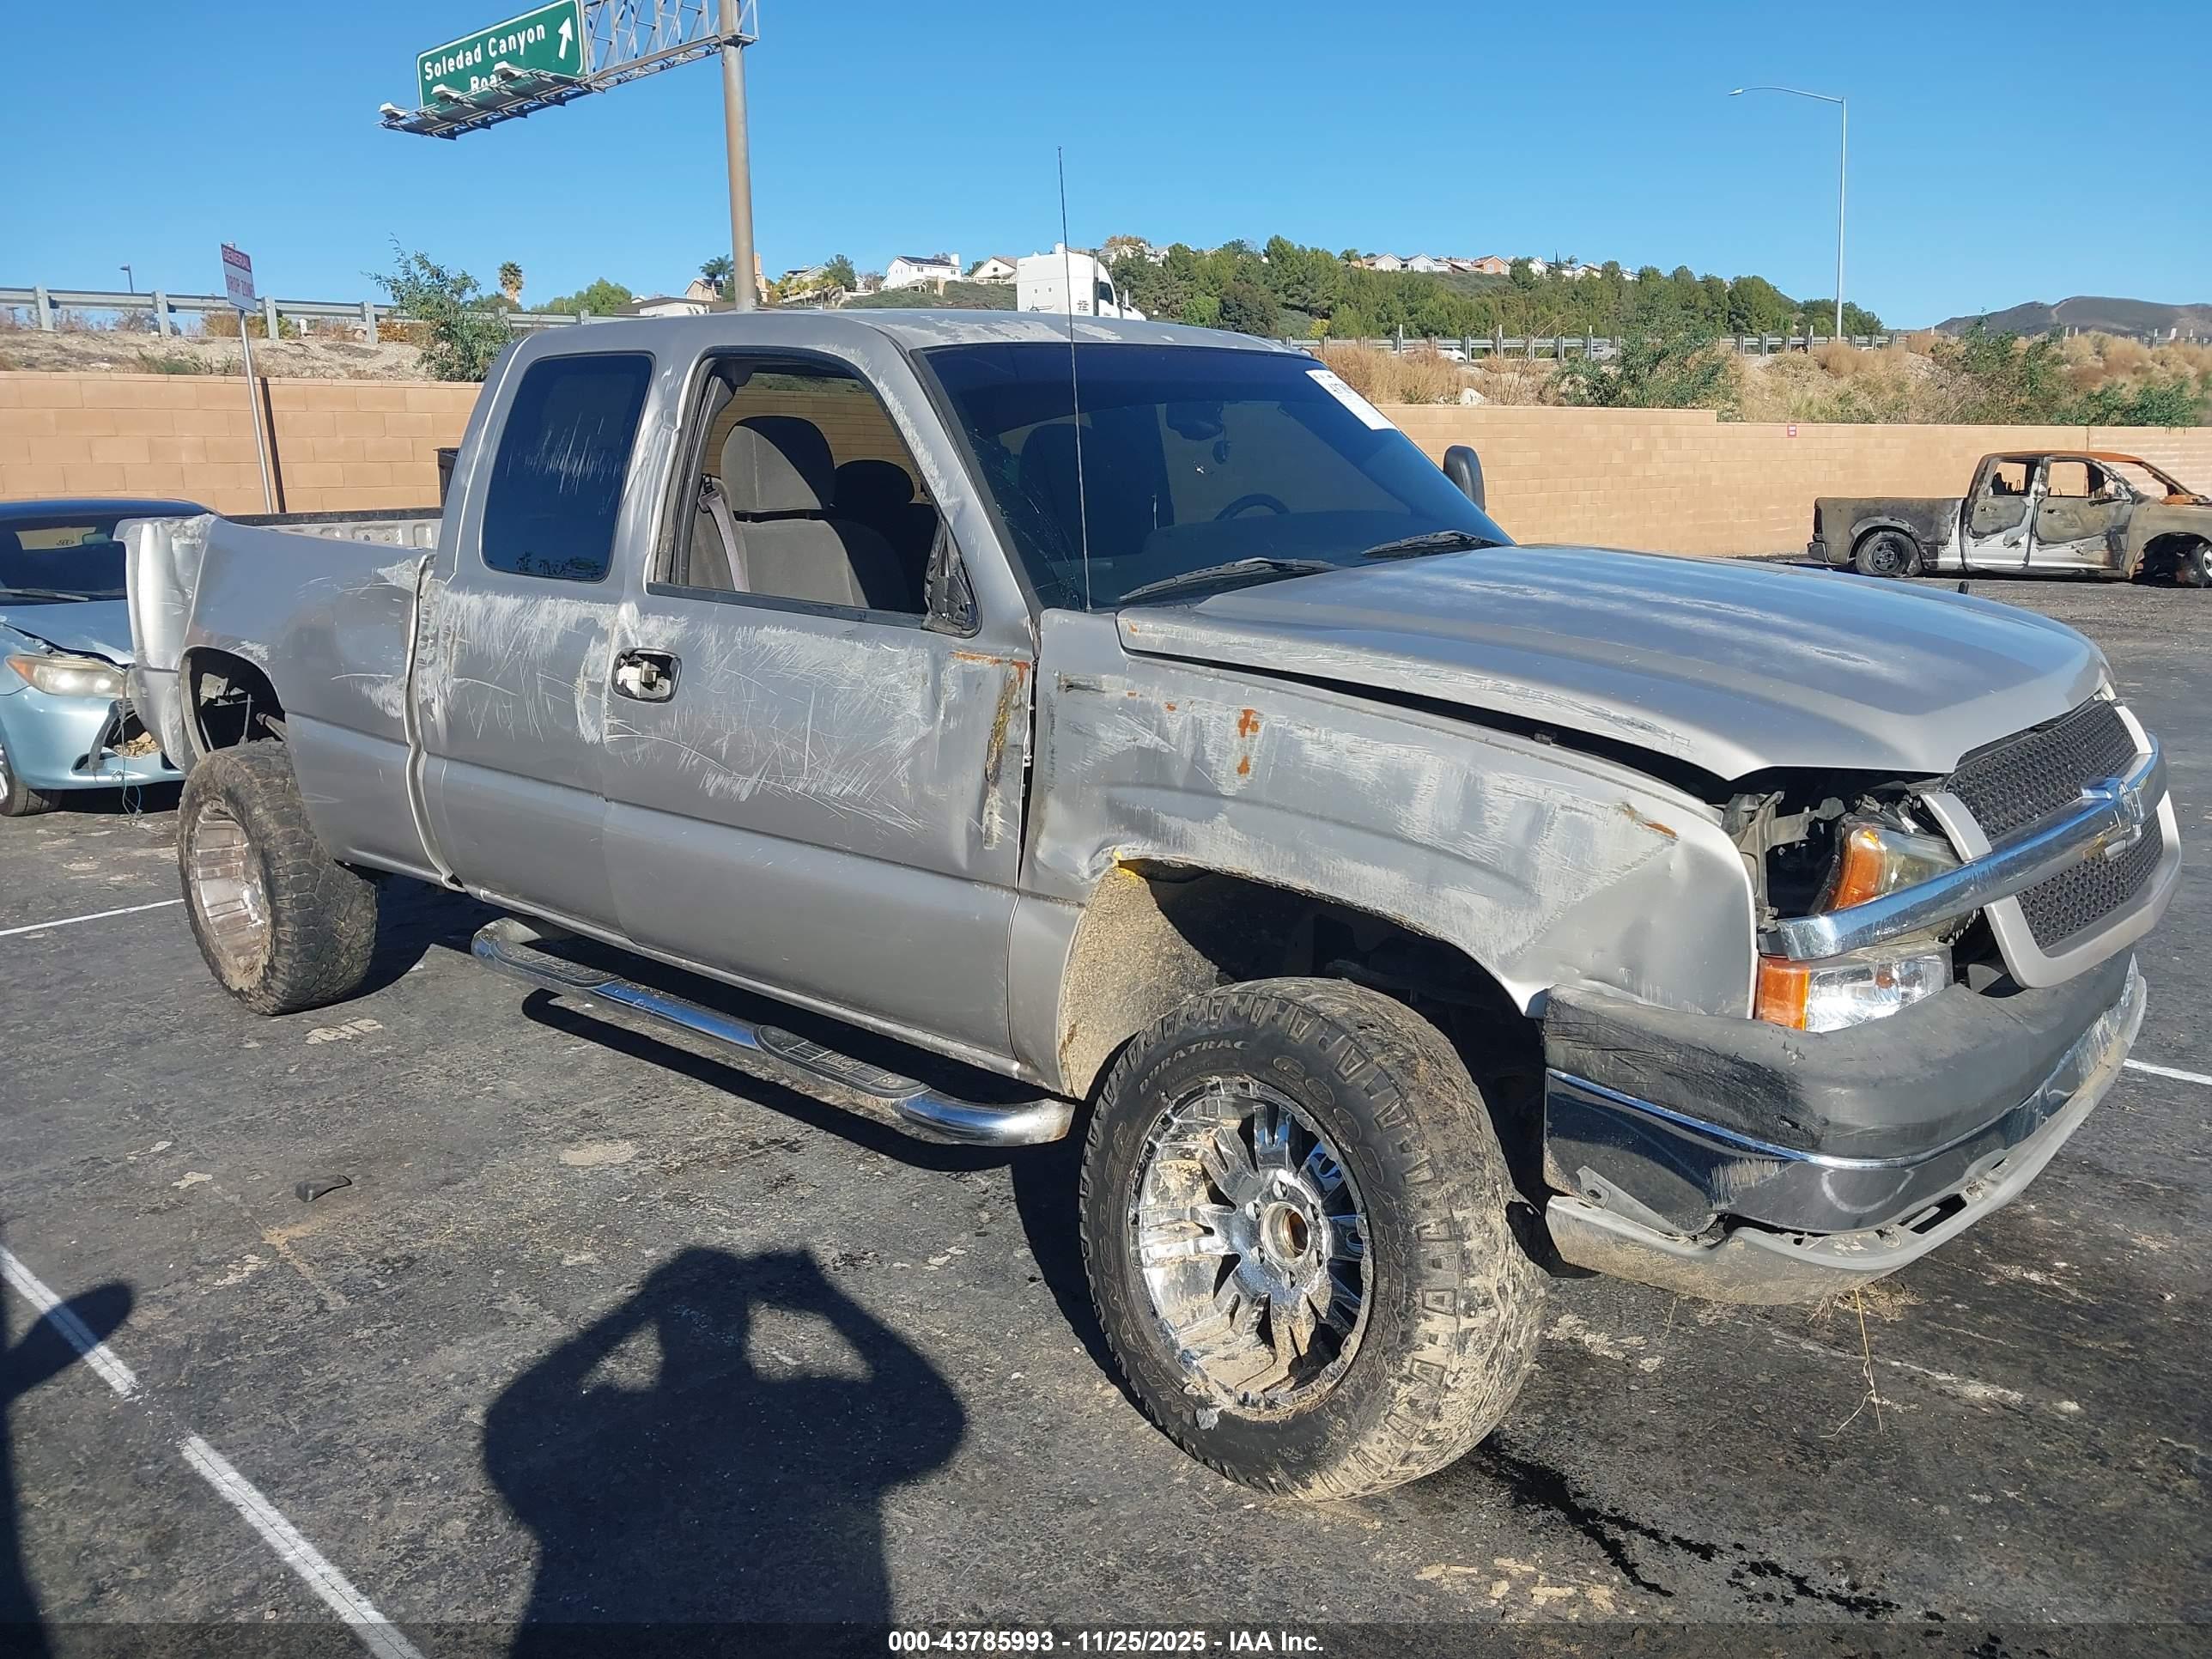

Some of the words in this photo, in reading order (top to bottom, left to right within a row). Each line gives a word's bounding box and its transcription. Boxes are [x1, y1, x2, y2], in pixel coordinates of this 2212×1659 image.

[424, 42, 482, 81] Soledad
[488, 23, 545, 58] Canyon
[470, 72, 503, 94] Roa
[1139, 1039, 1250, 1096] DURATRAC
